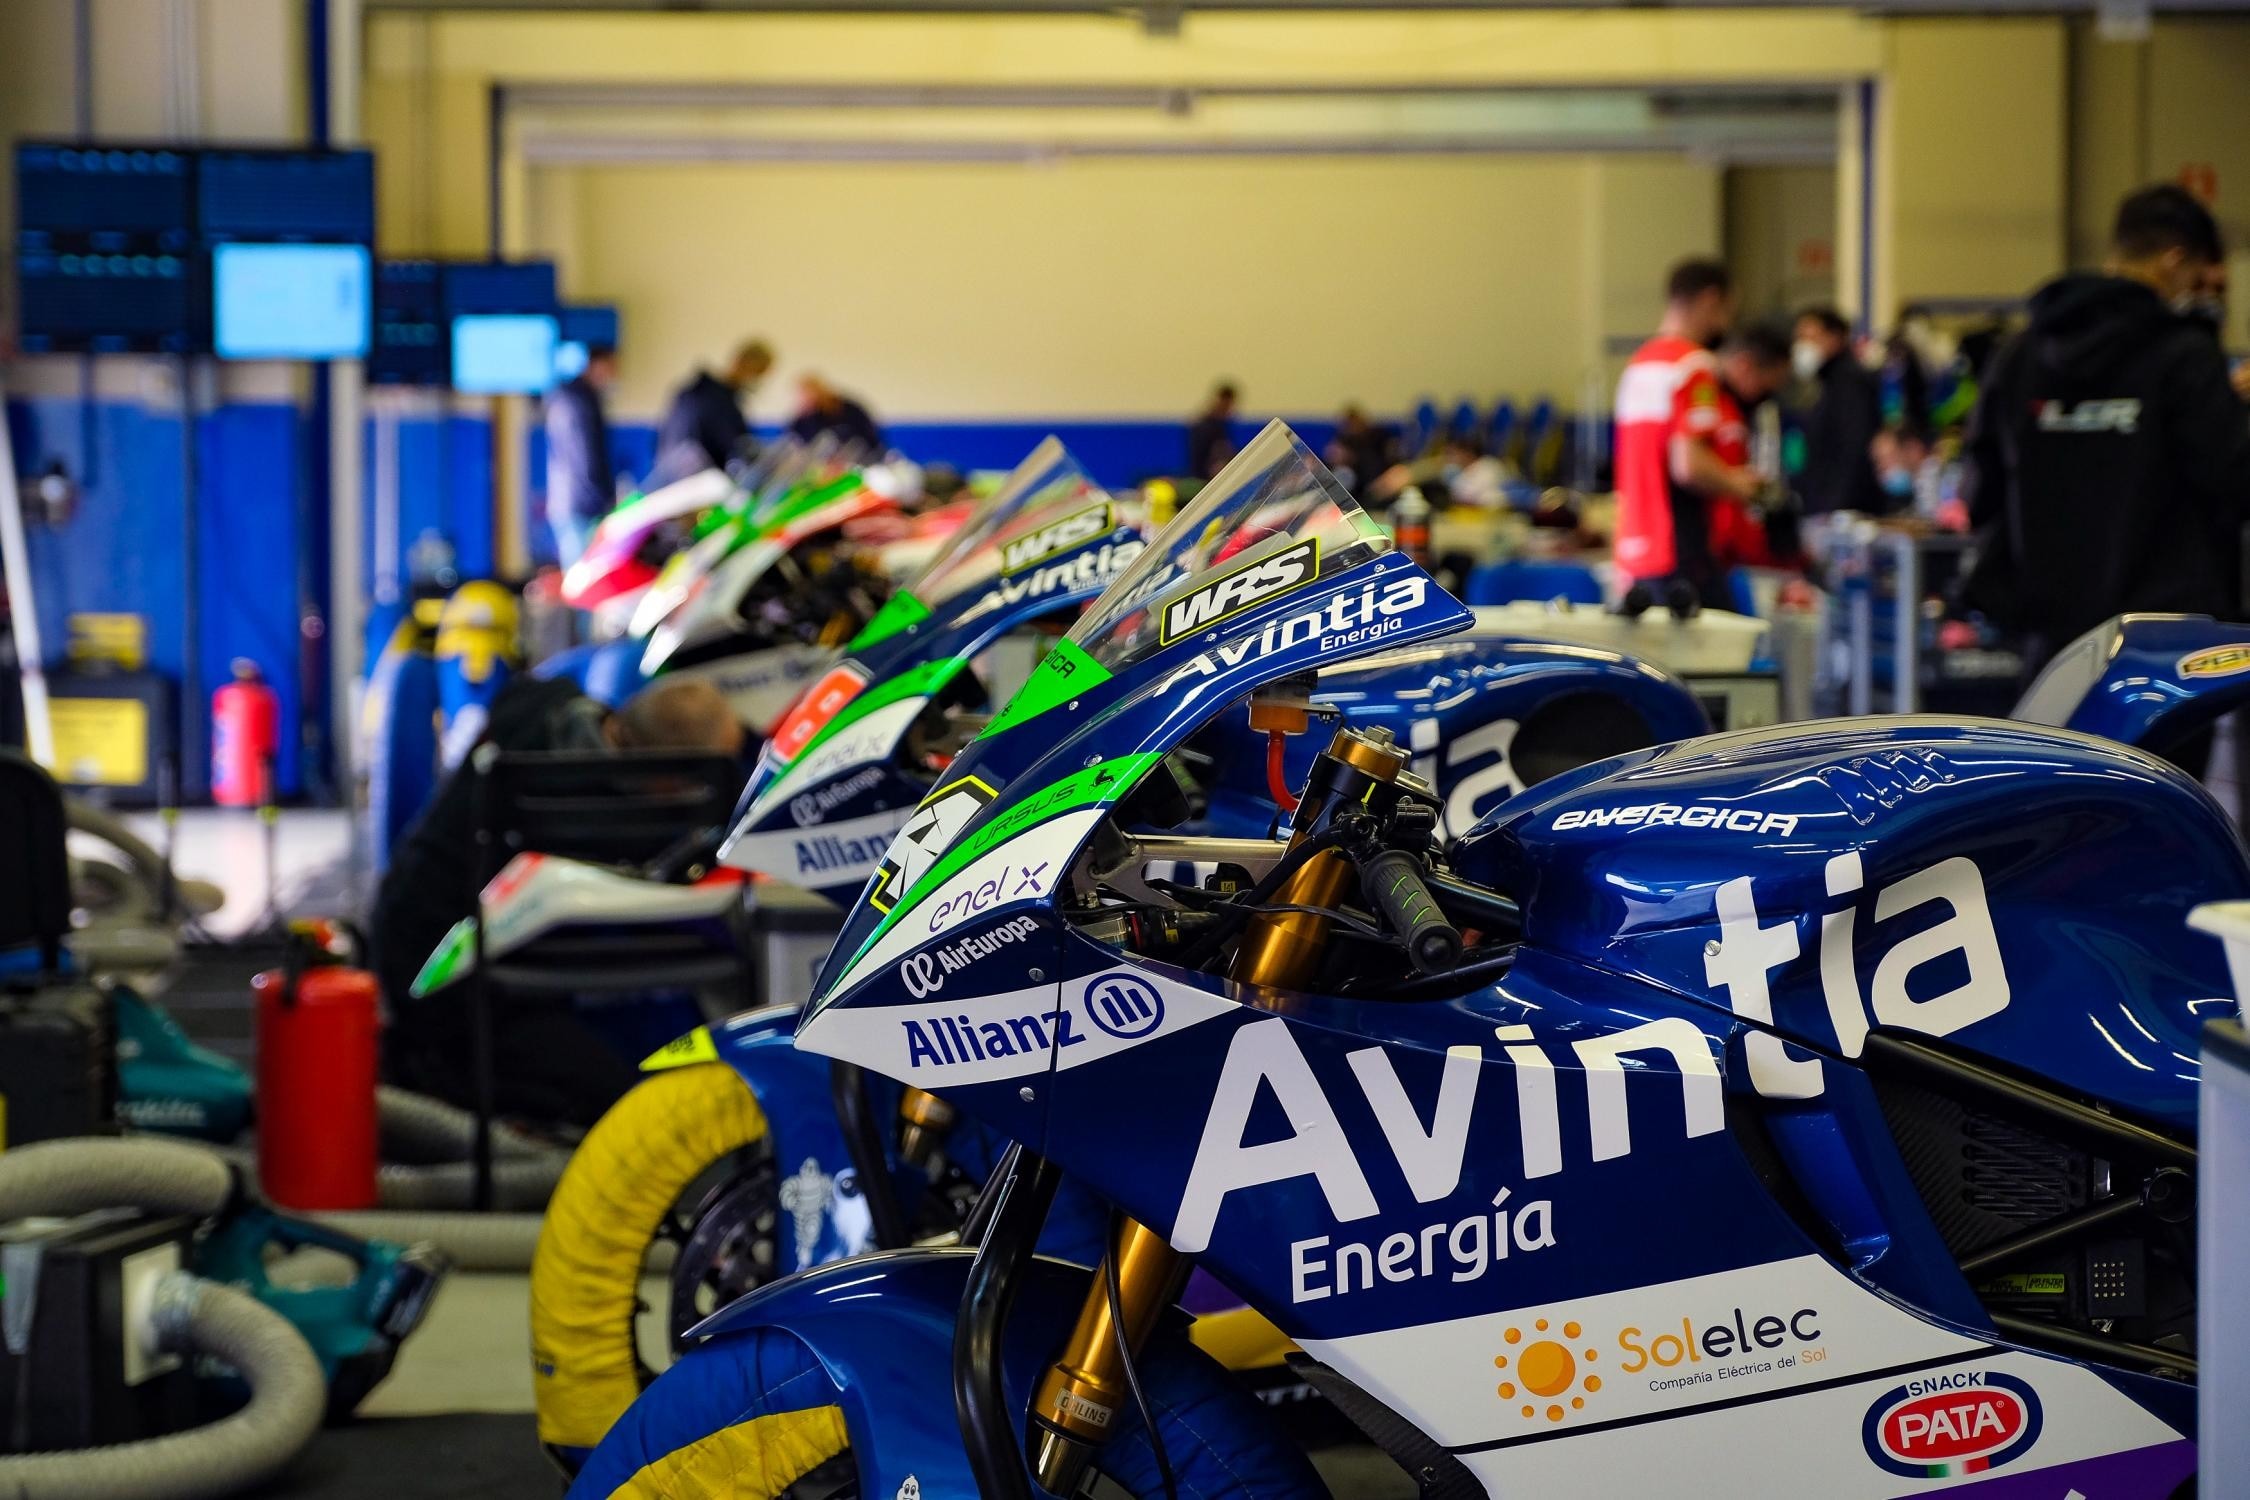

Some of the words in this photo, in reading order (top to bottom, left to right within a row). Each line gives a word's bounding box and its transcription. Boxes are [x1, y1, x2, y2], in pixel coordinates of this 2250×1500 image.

[1170, 545, 1310, 637] WRS
[1153, 575, 1430, 698] Avintia
[1320, 614, 1403, 651] Energía
[973, 783, 1078, 850] URSUS
[929, 866, 1009, 932] enel
[937, 915, 1039, 974] AirEuropa
[901, 1009, 1087, 1068] Allianz
[1291, 1187, 1556, 1303] Energía
[1618, 1308, 1821, 1373] Solelec
[1649, 1372, 1713, 1392] Compañía
[1718, 1361, 1772, 1380] Eléctrica
[1777, 1356, 1796, 1369] del
[1801, 1348, 1827, 1364] Sol
[1909, 1371, 1982, 1396] SNACK
[1898, 1401, 2006, 1449] PATA
